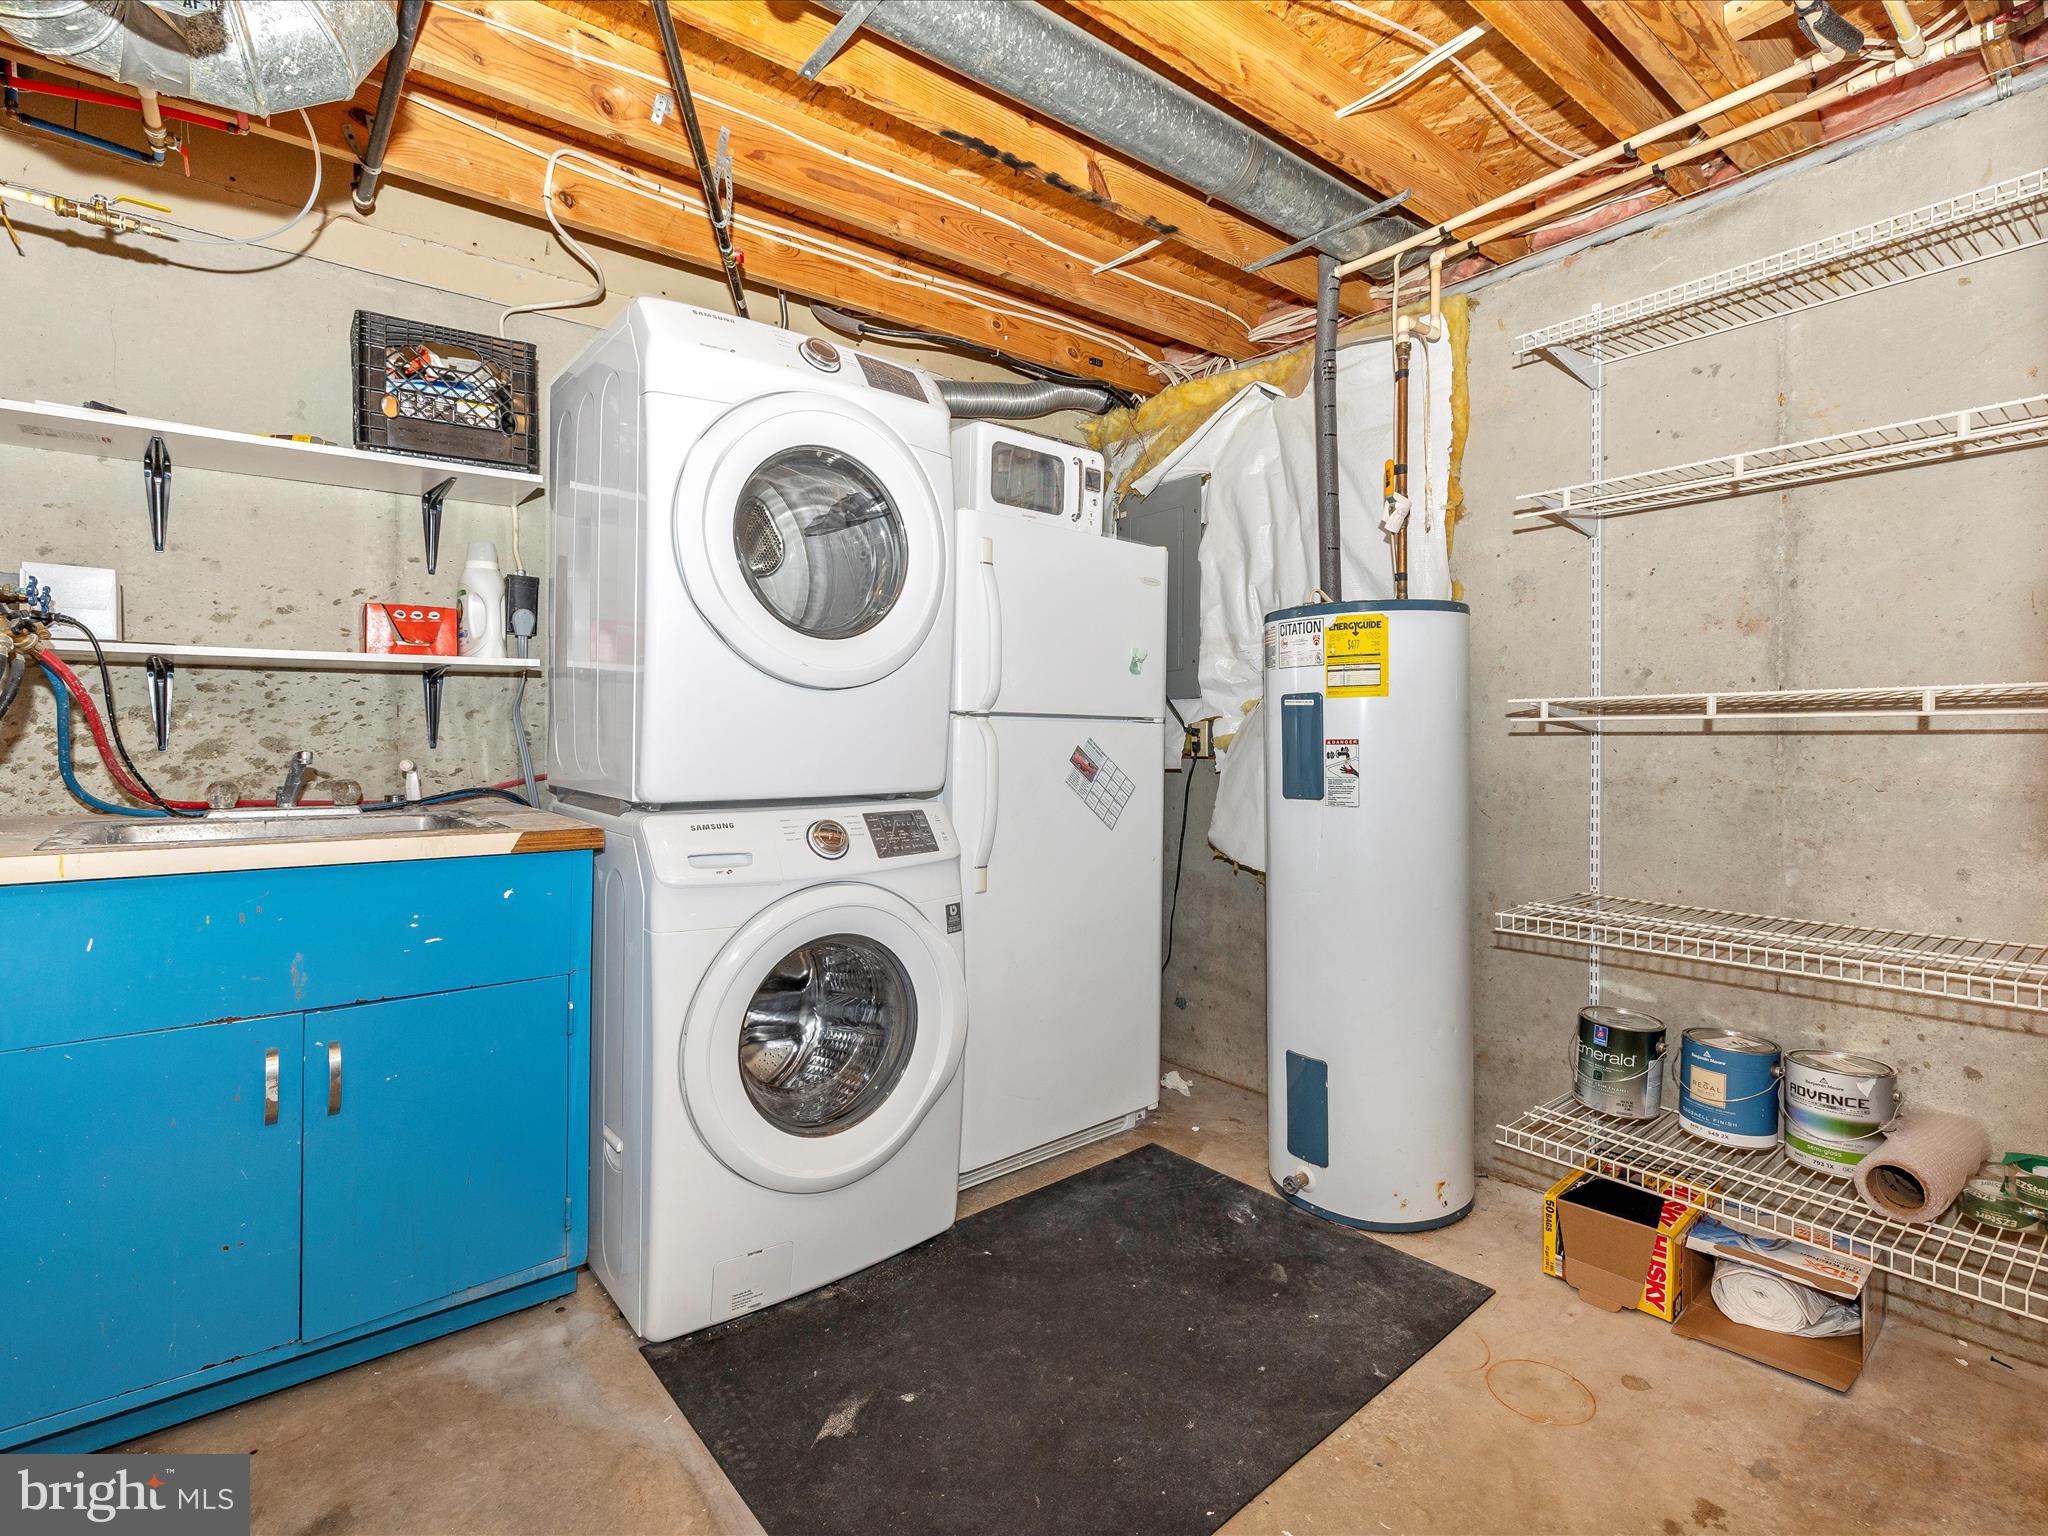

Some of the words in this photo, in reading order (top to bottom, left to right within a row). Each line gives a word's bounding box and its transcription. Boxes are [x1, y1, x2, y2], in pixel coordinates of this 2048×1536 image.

[692, 309, 736, 324] SAMSUNG
[1280, 620, 1321, 637] CITATION
[690, 822, 735, 832] SAMSUNG
[1577, 1039, 1635, 1068] Emerald
[1692, 1079, 1722, 1094] REGAL
[1790, 1082, 1870, 1110] ADVANCE
[1807, 1144, 1843, 1158] semi-gloss
[1545, 1199, 1555, 1214] 50
[1545, 1213, 1553, 1232] BAGS
[1975, 1210, 2018, 1229] EZStart
[1645, 1234, 1668, 1313] HUSKY
[1802, 1259, 1860, 1283] HDX
